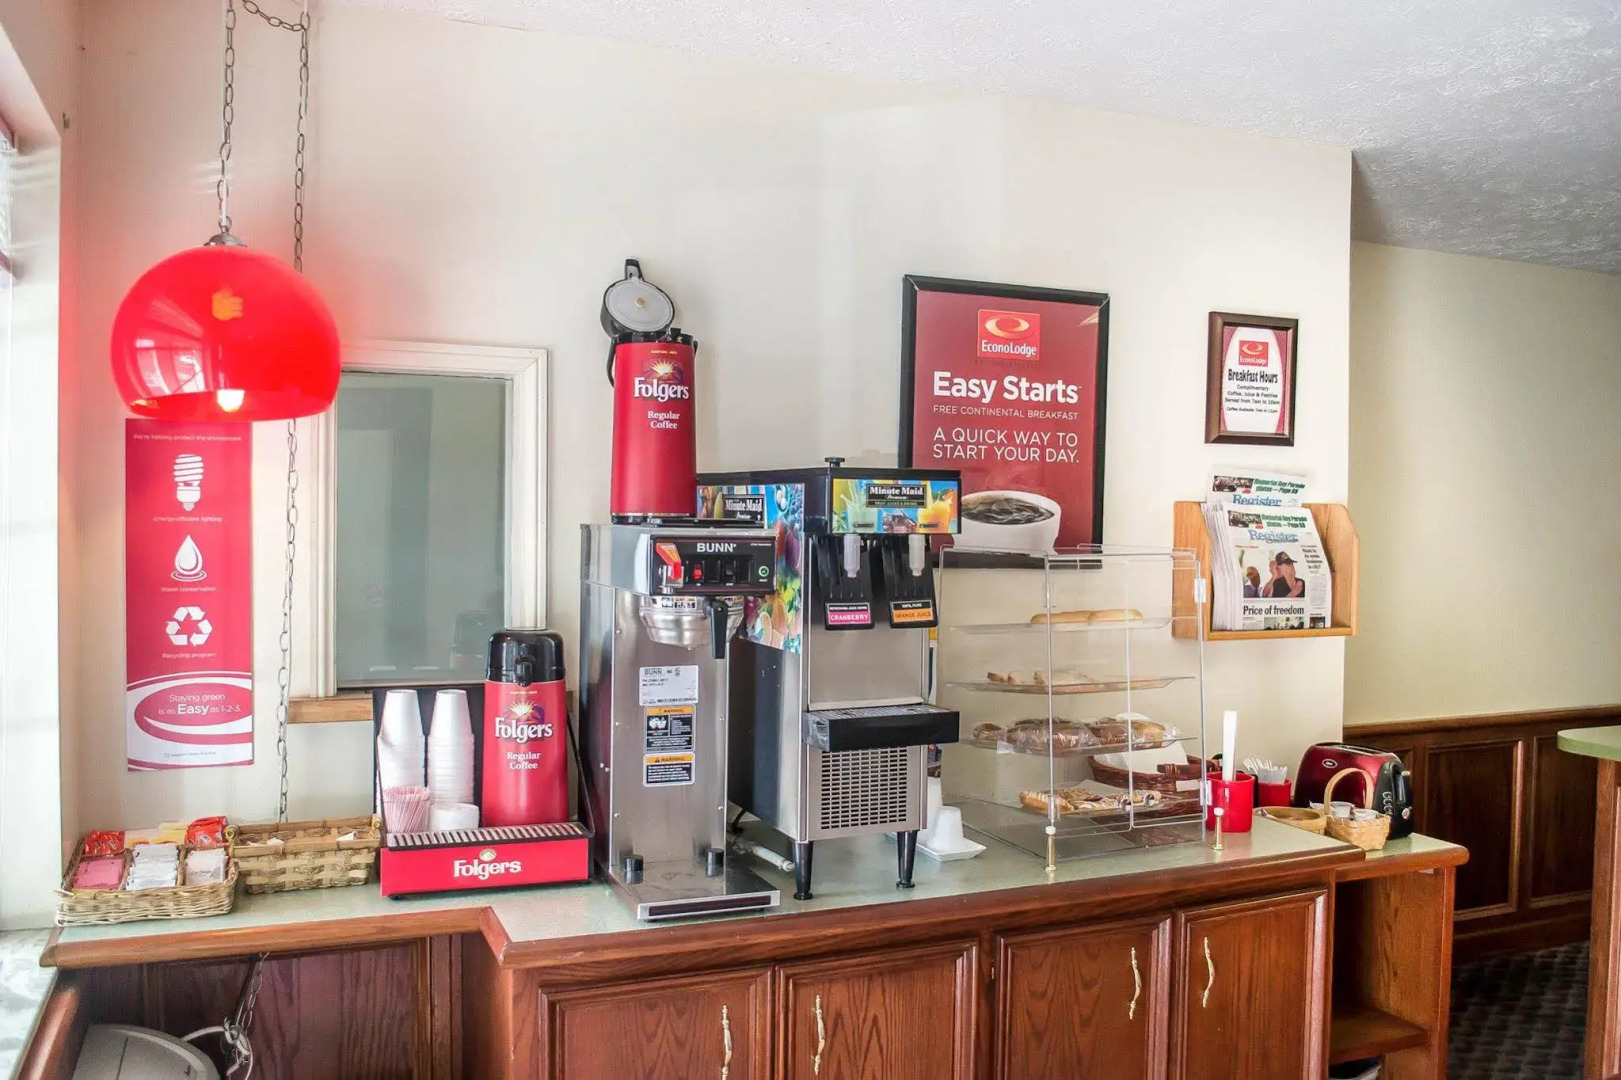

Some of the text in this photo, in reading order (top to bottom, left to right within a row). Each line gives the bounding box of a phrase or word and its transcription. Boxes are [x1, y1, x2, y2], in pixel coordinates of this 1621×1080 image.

[981, 340, 1037, 358] EconoLodge
[1228, 369, 1278, 383] Breakfast Hours
[634, 377, 689, 402] Folgers
[933, 371, 997, 404] Easy
[647, 411, 680, 420] Regular
[933, 405, 1078, 420] FREE CONTINENTAL BREAKFAST
[650, 420, 678, 429] Coffee
[933, 427, 1078, 447] A QUICK WAY TO
[933, 444, 1080, 463] START YOUR DAY.
[869, 486, 923, 495] Minute Maid
[725, 498, 763, 511] Minute Maid
[1248, 529, 1298, 543] Register
[1243, 605, 1305, 615] Price of freedom
[830, 613, 869, 621] CRANBERRY
[169, 694, 226, 703] Staying green
[178, 703, 209, 716] Easy
[495, 717, 553, 743] Folgers
[507, 751, 541, 761] Regular
[509, 761, 538, 770] Coffee
[453, 859, 522, 880] Folgers
